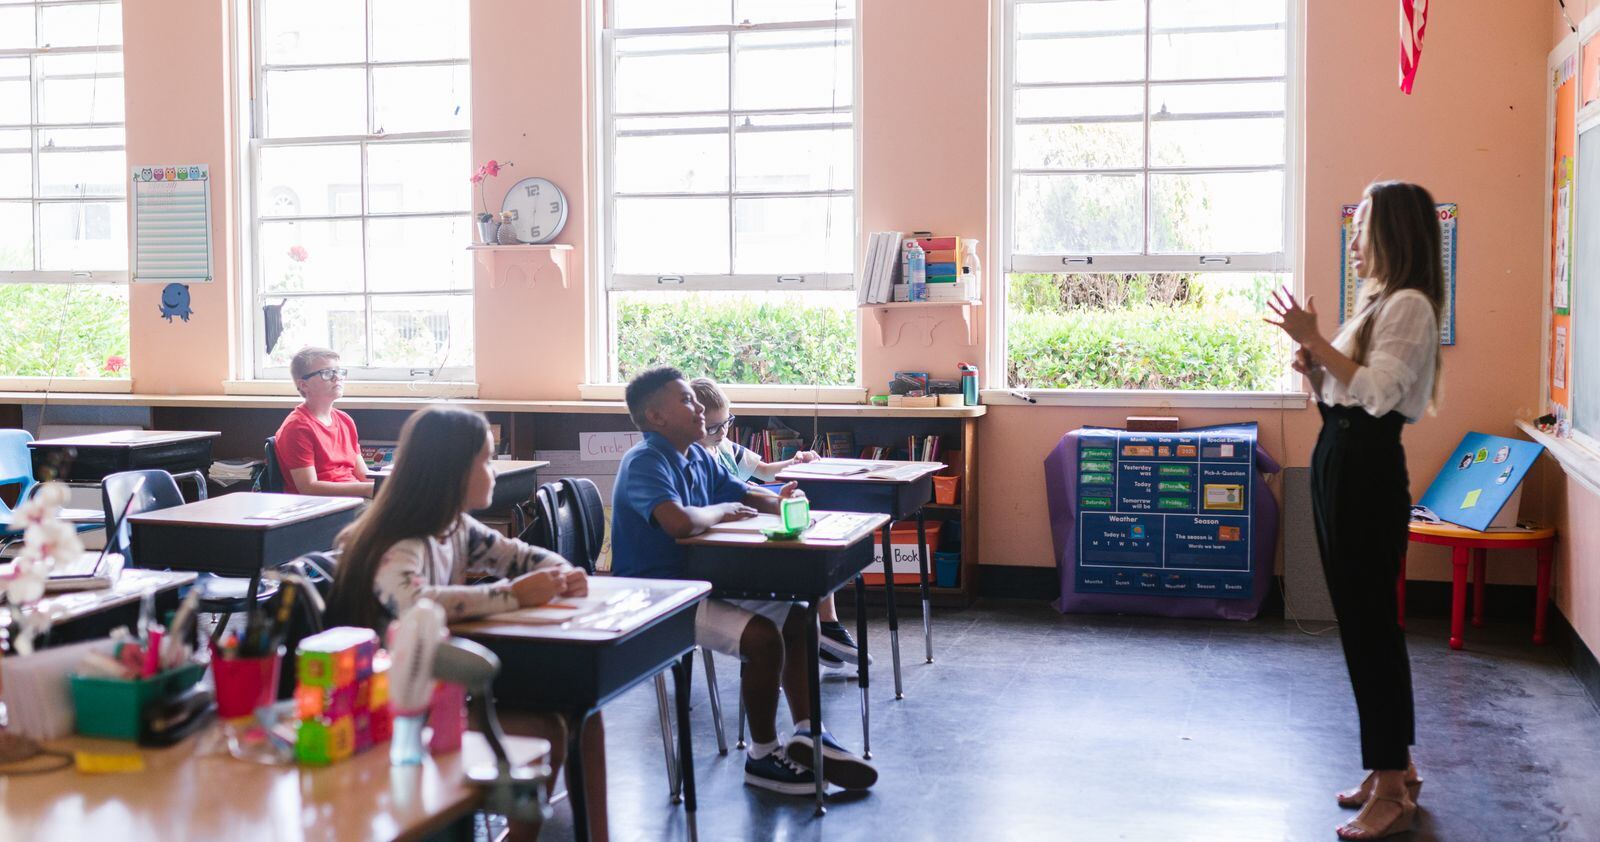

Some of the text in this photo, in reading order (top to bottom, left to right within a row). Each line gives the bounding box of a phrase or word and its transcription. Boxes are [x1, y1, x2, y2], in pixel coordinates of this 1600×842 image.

[524, 184, 540, 197] 12
[550, 201, 560, 214] 3
[530, 226, 541, 238] 6
[587, 434, 624, 455] Circle
[1109, 515, 1138, 523] Weather
[1193, 517, 1219, 525] Season
